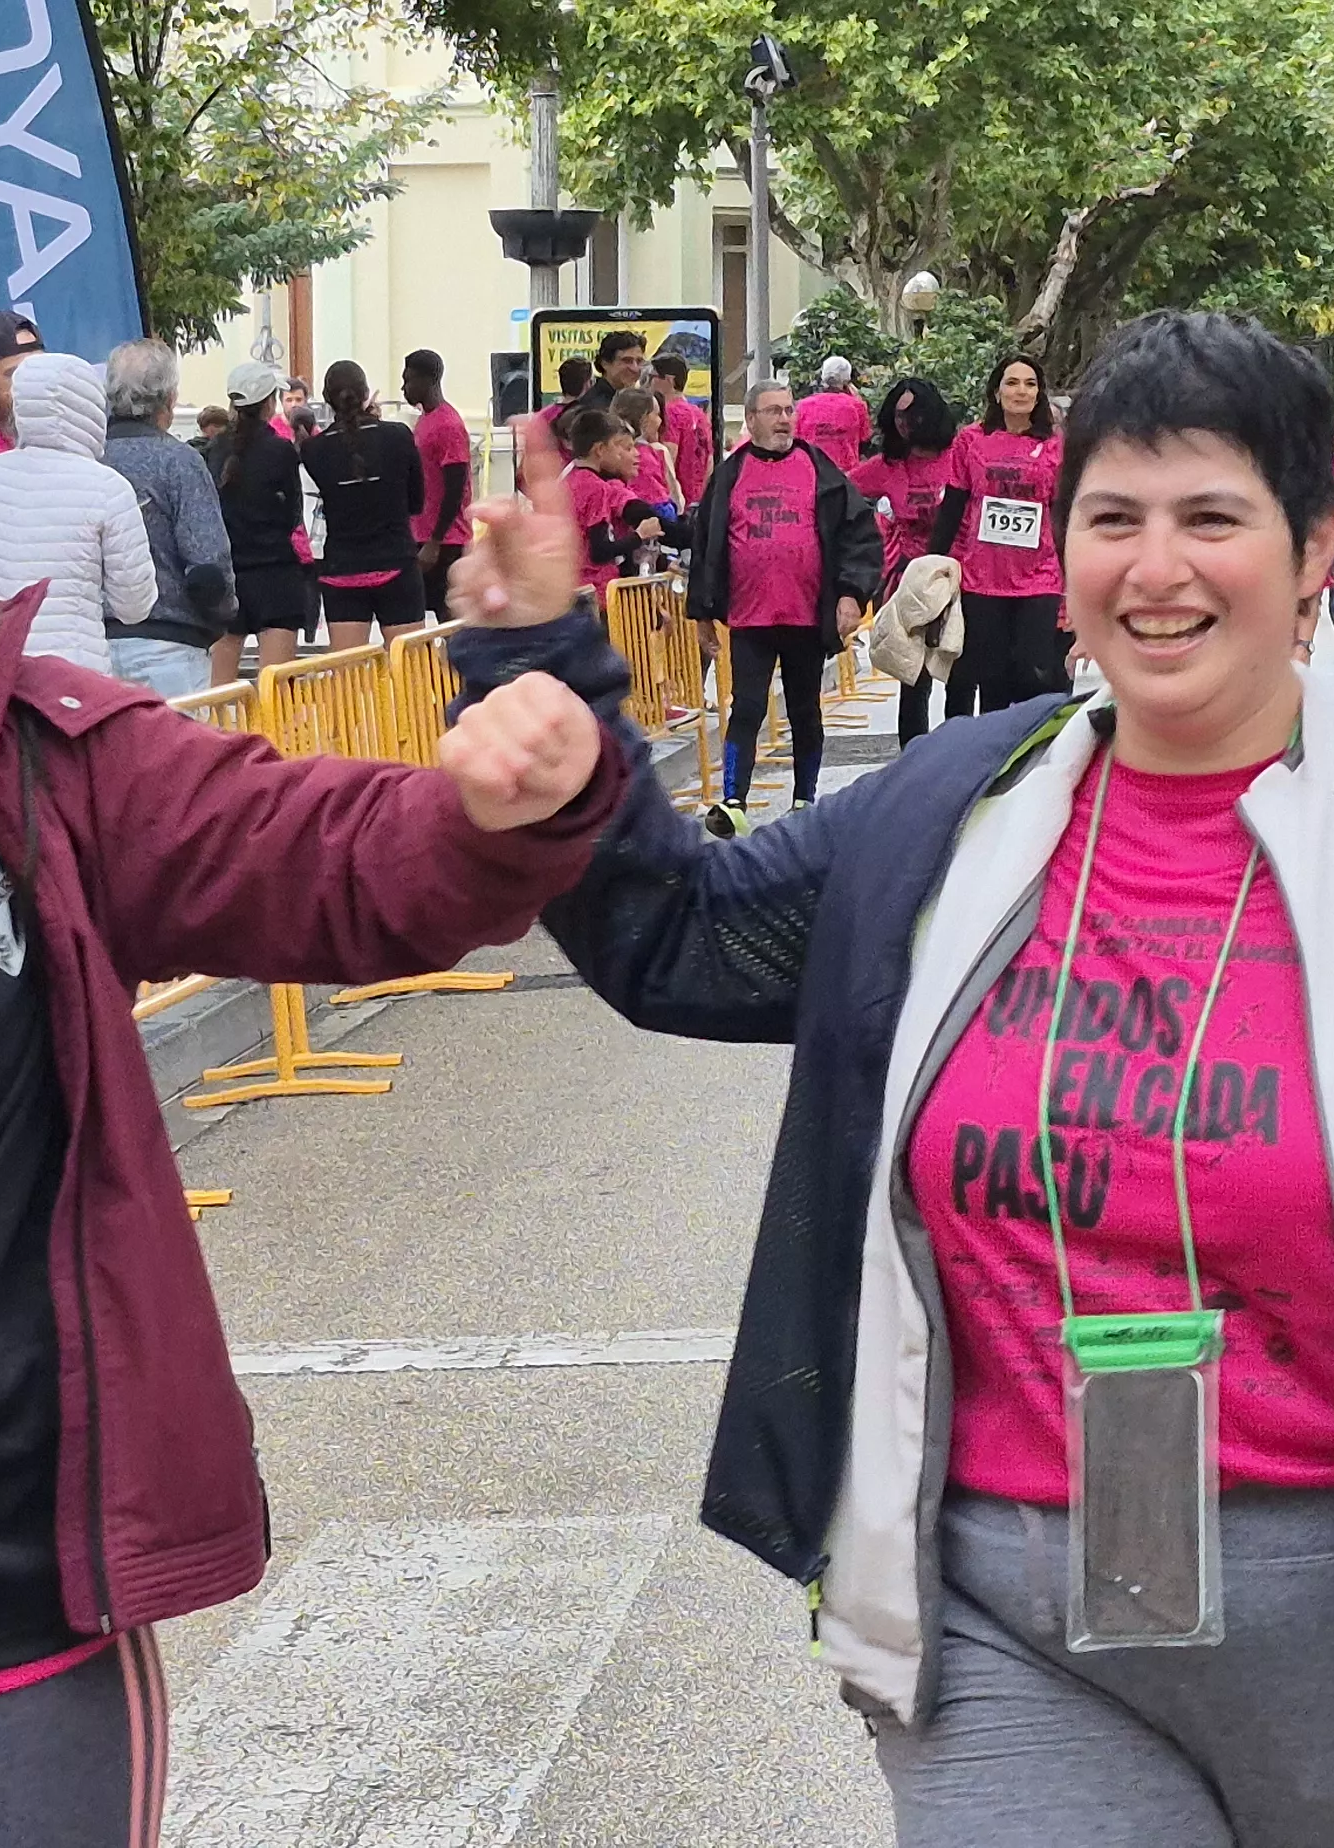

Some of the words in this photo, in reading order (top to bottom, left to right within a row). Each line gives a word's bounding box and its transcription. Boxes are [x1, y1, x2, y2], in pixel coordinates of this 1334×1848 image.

[547, 328, 594, 345] VISITAS
[987, 512, 1036, 534] 1957
[1049, 1050, 1128, 1130] EN
[1133, 1062, 1283, 1146] CADA
